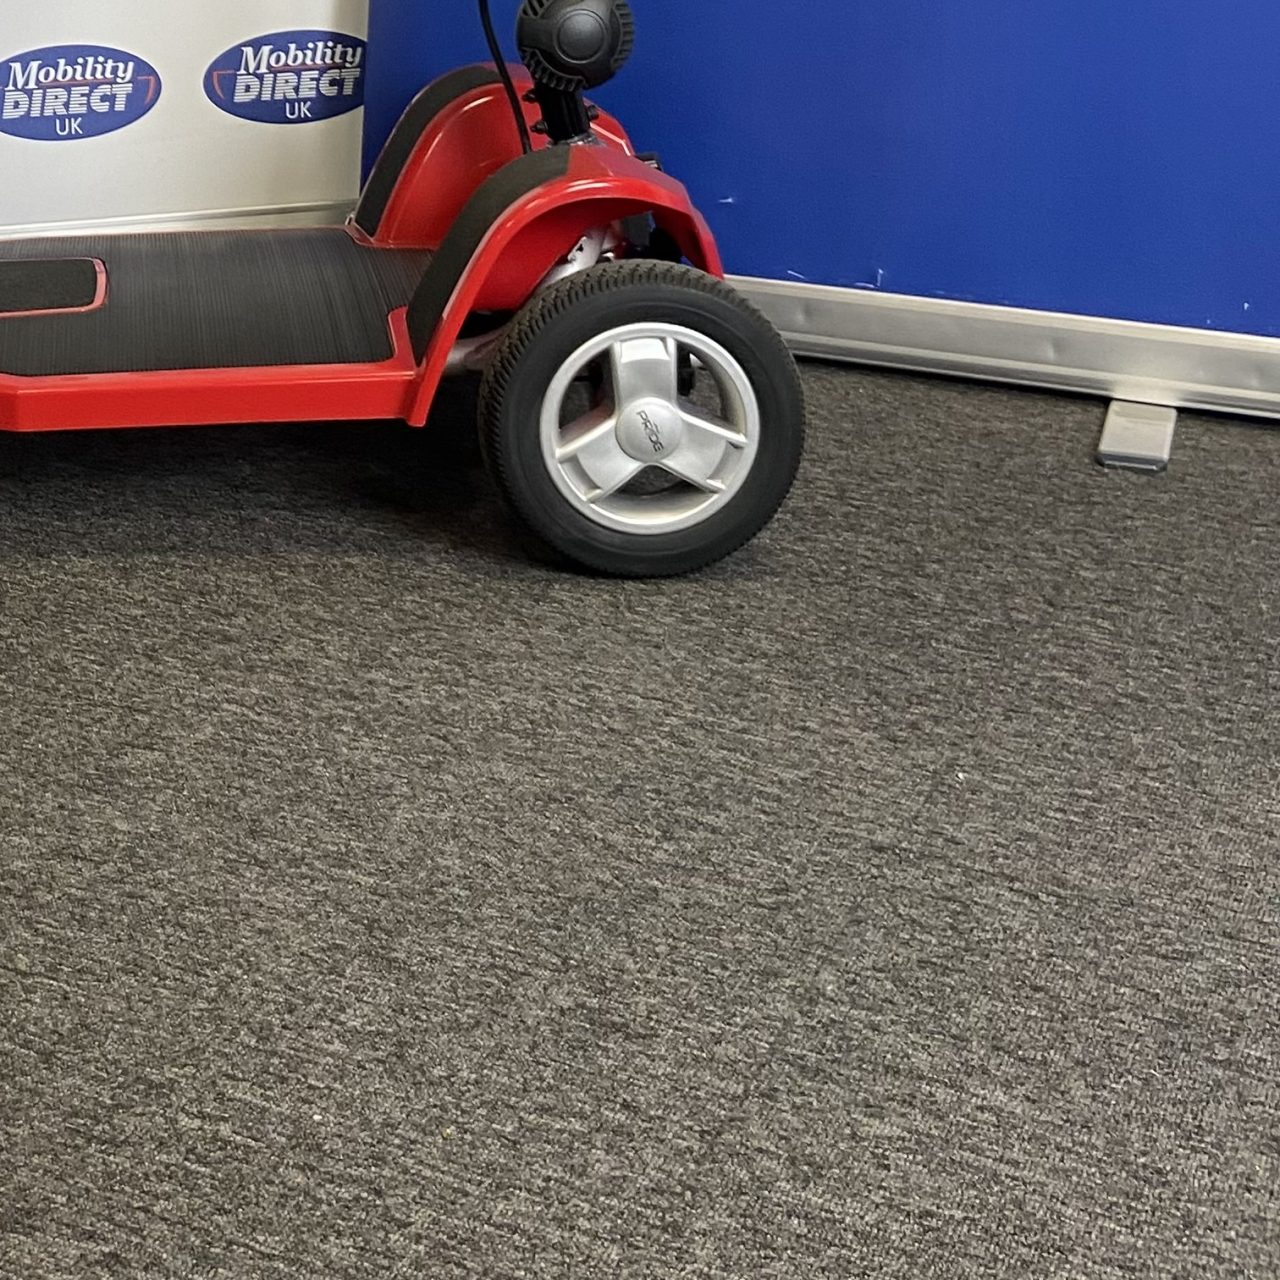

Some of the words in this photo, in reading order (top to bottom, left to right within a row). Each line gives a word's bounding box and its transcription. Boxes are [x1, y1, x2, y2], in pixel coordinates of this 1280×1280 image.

[8, 56, 135, 88] Mobility
[237, 41, 363, 74] Mobility
[1, 83, 134, 119] DIRECT
[234, 68, 360, 102] DIRECT
[286, 101, 312, 118] UK
[56, 117, 83, 135] UK
